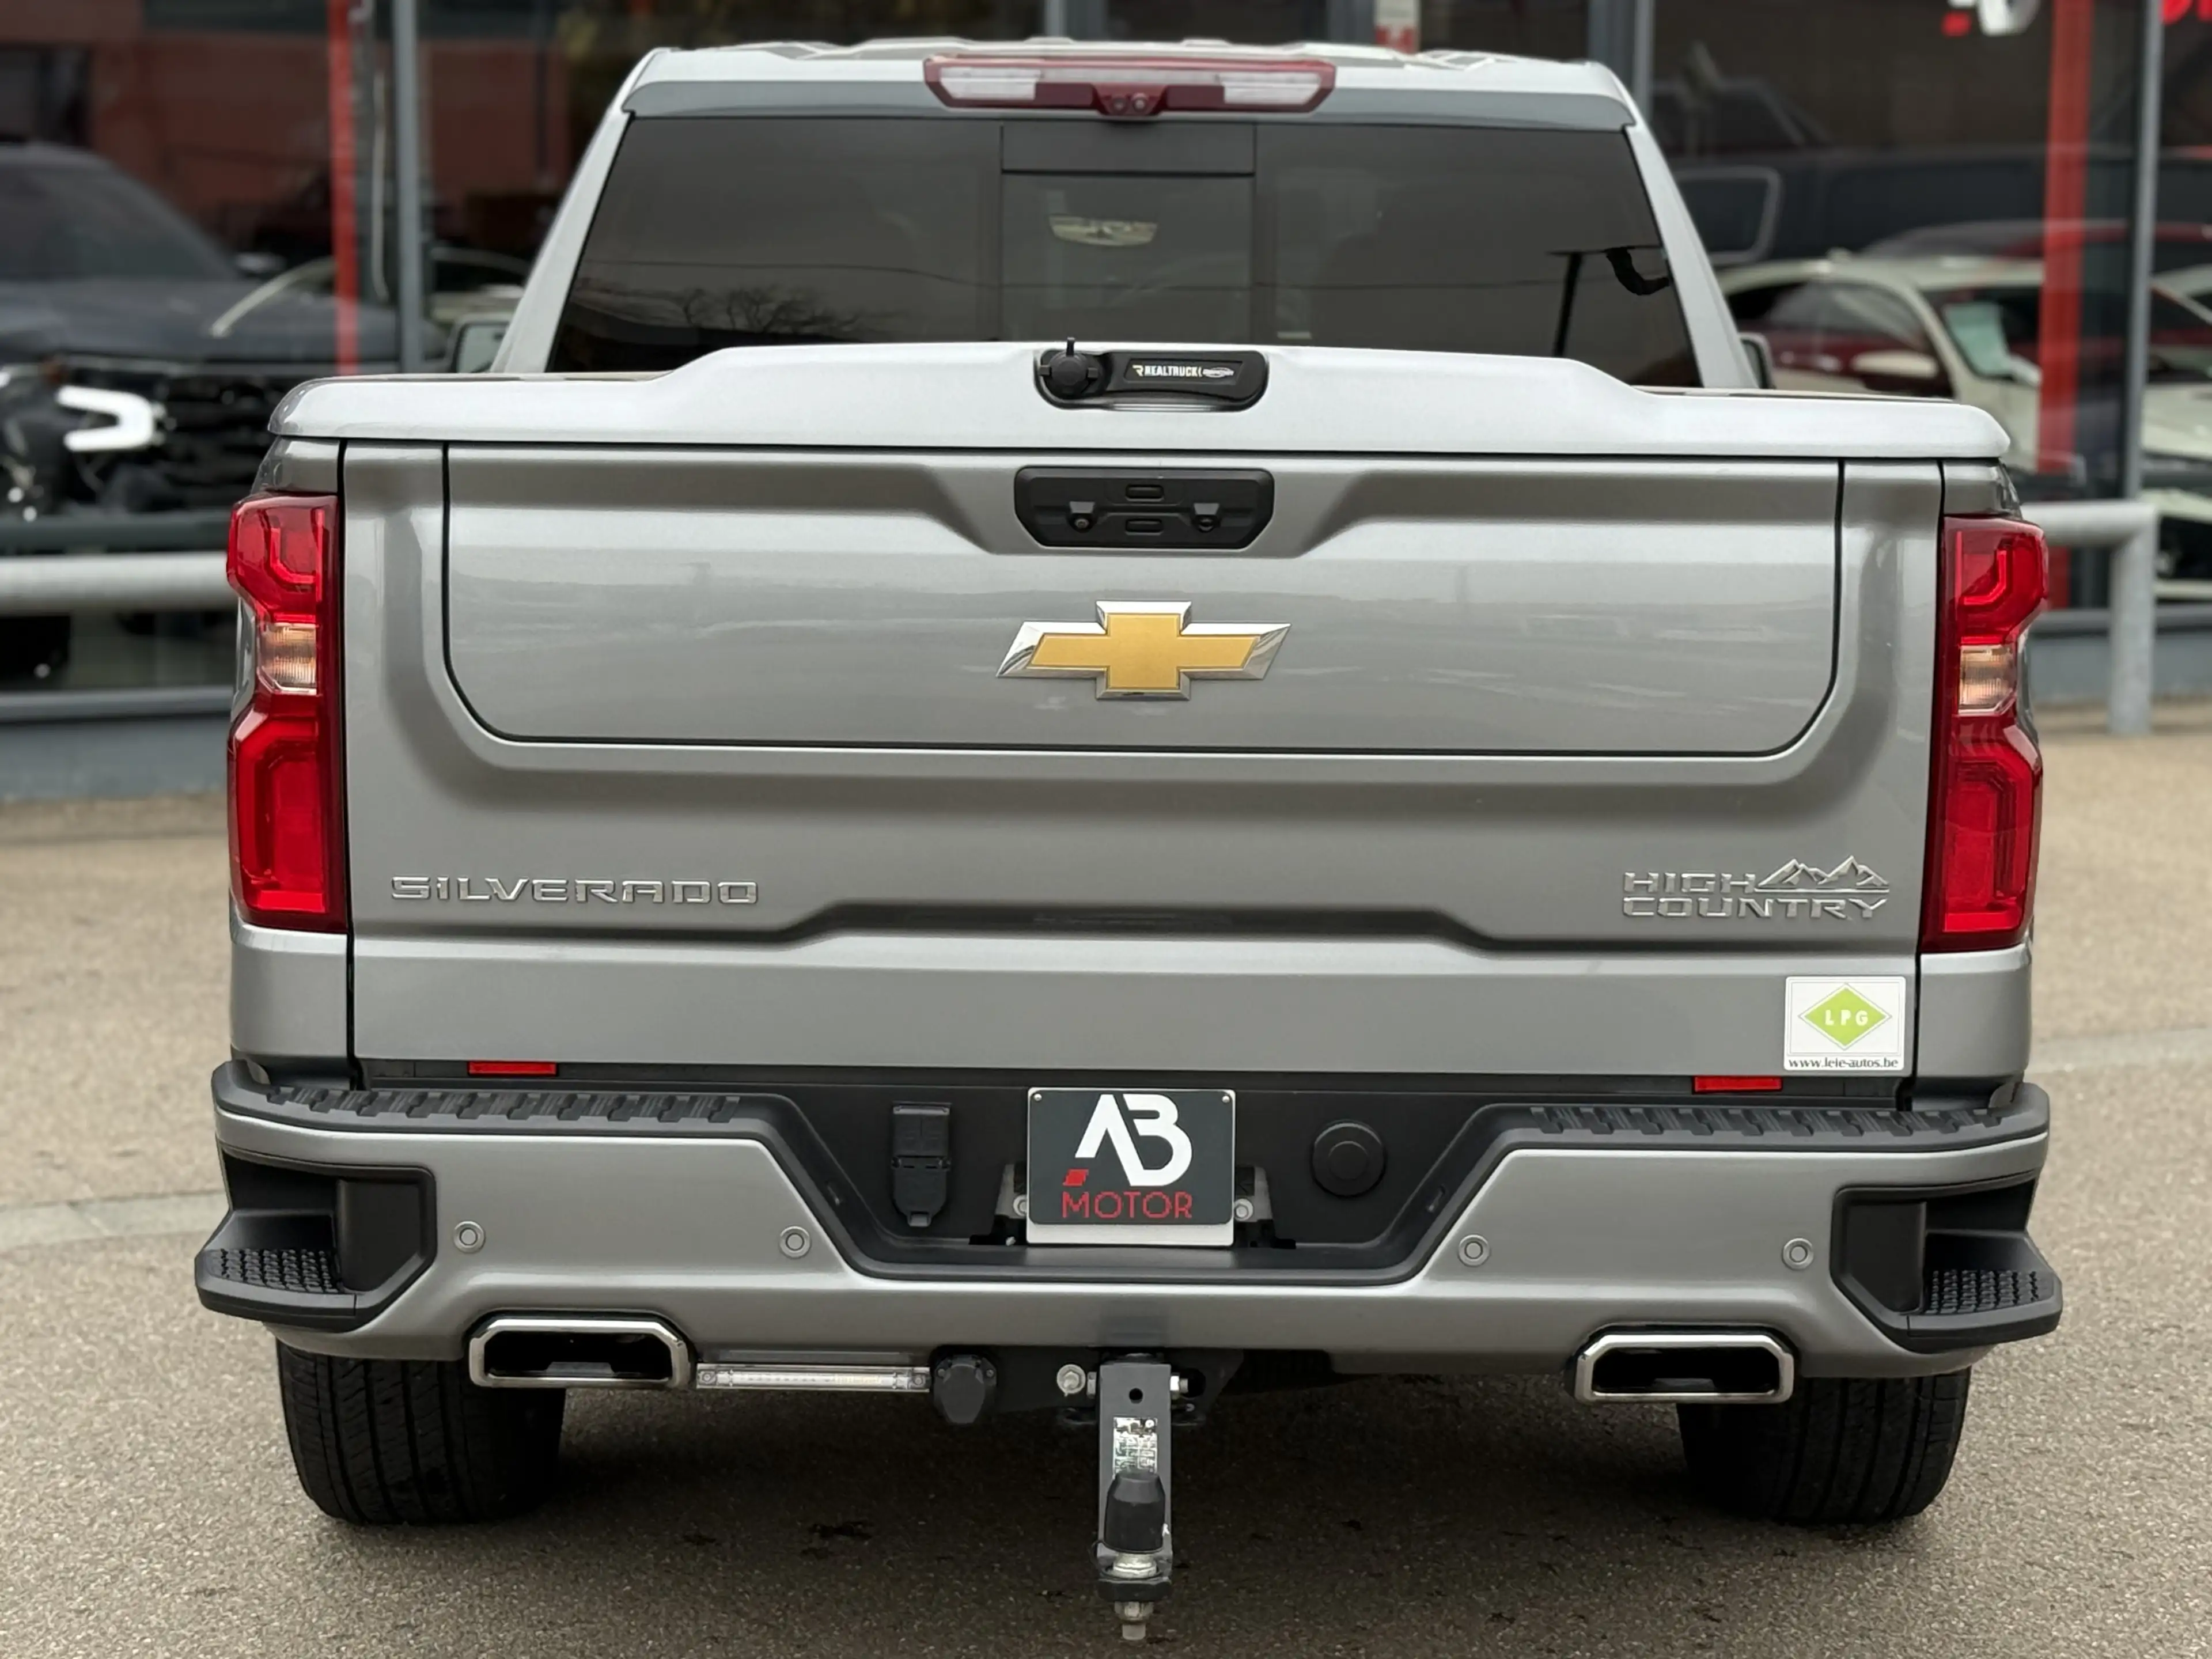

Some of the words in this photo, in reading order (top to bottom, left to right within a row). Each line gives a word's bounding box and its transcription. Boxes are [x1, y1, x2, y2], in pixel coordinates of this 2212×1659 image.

[1144, 365, 1198, 377] REALTRUCK
[392, 876, 758, 904] SILVERADO
[1624, 872, 1756, 893] HIGH
[1623, 897, 1888, 918] COUNTRY
[1825, 1009, 1868, 1026] LPG
[1789, 1057, 1899, 1068] www.leie-autos.be
[1075, 1094, 1192, 1187] AB
[1062, 1191, 1192, 1218] MOTOR
